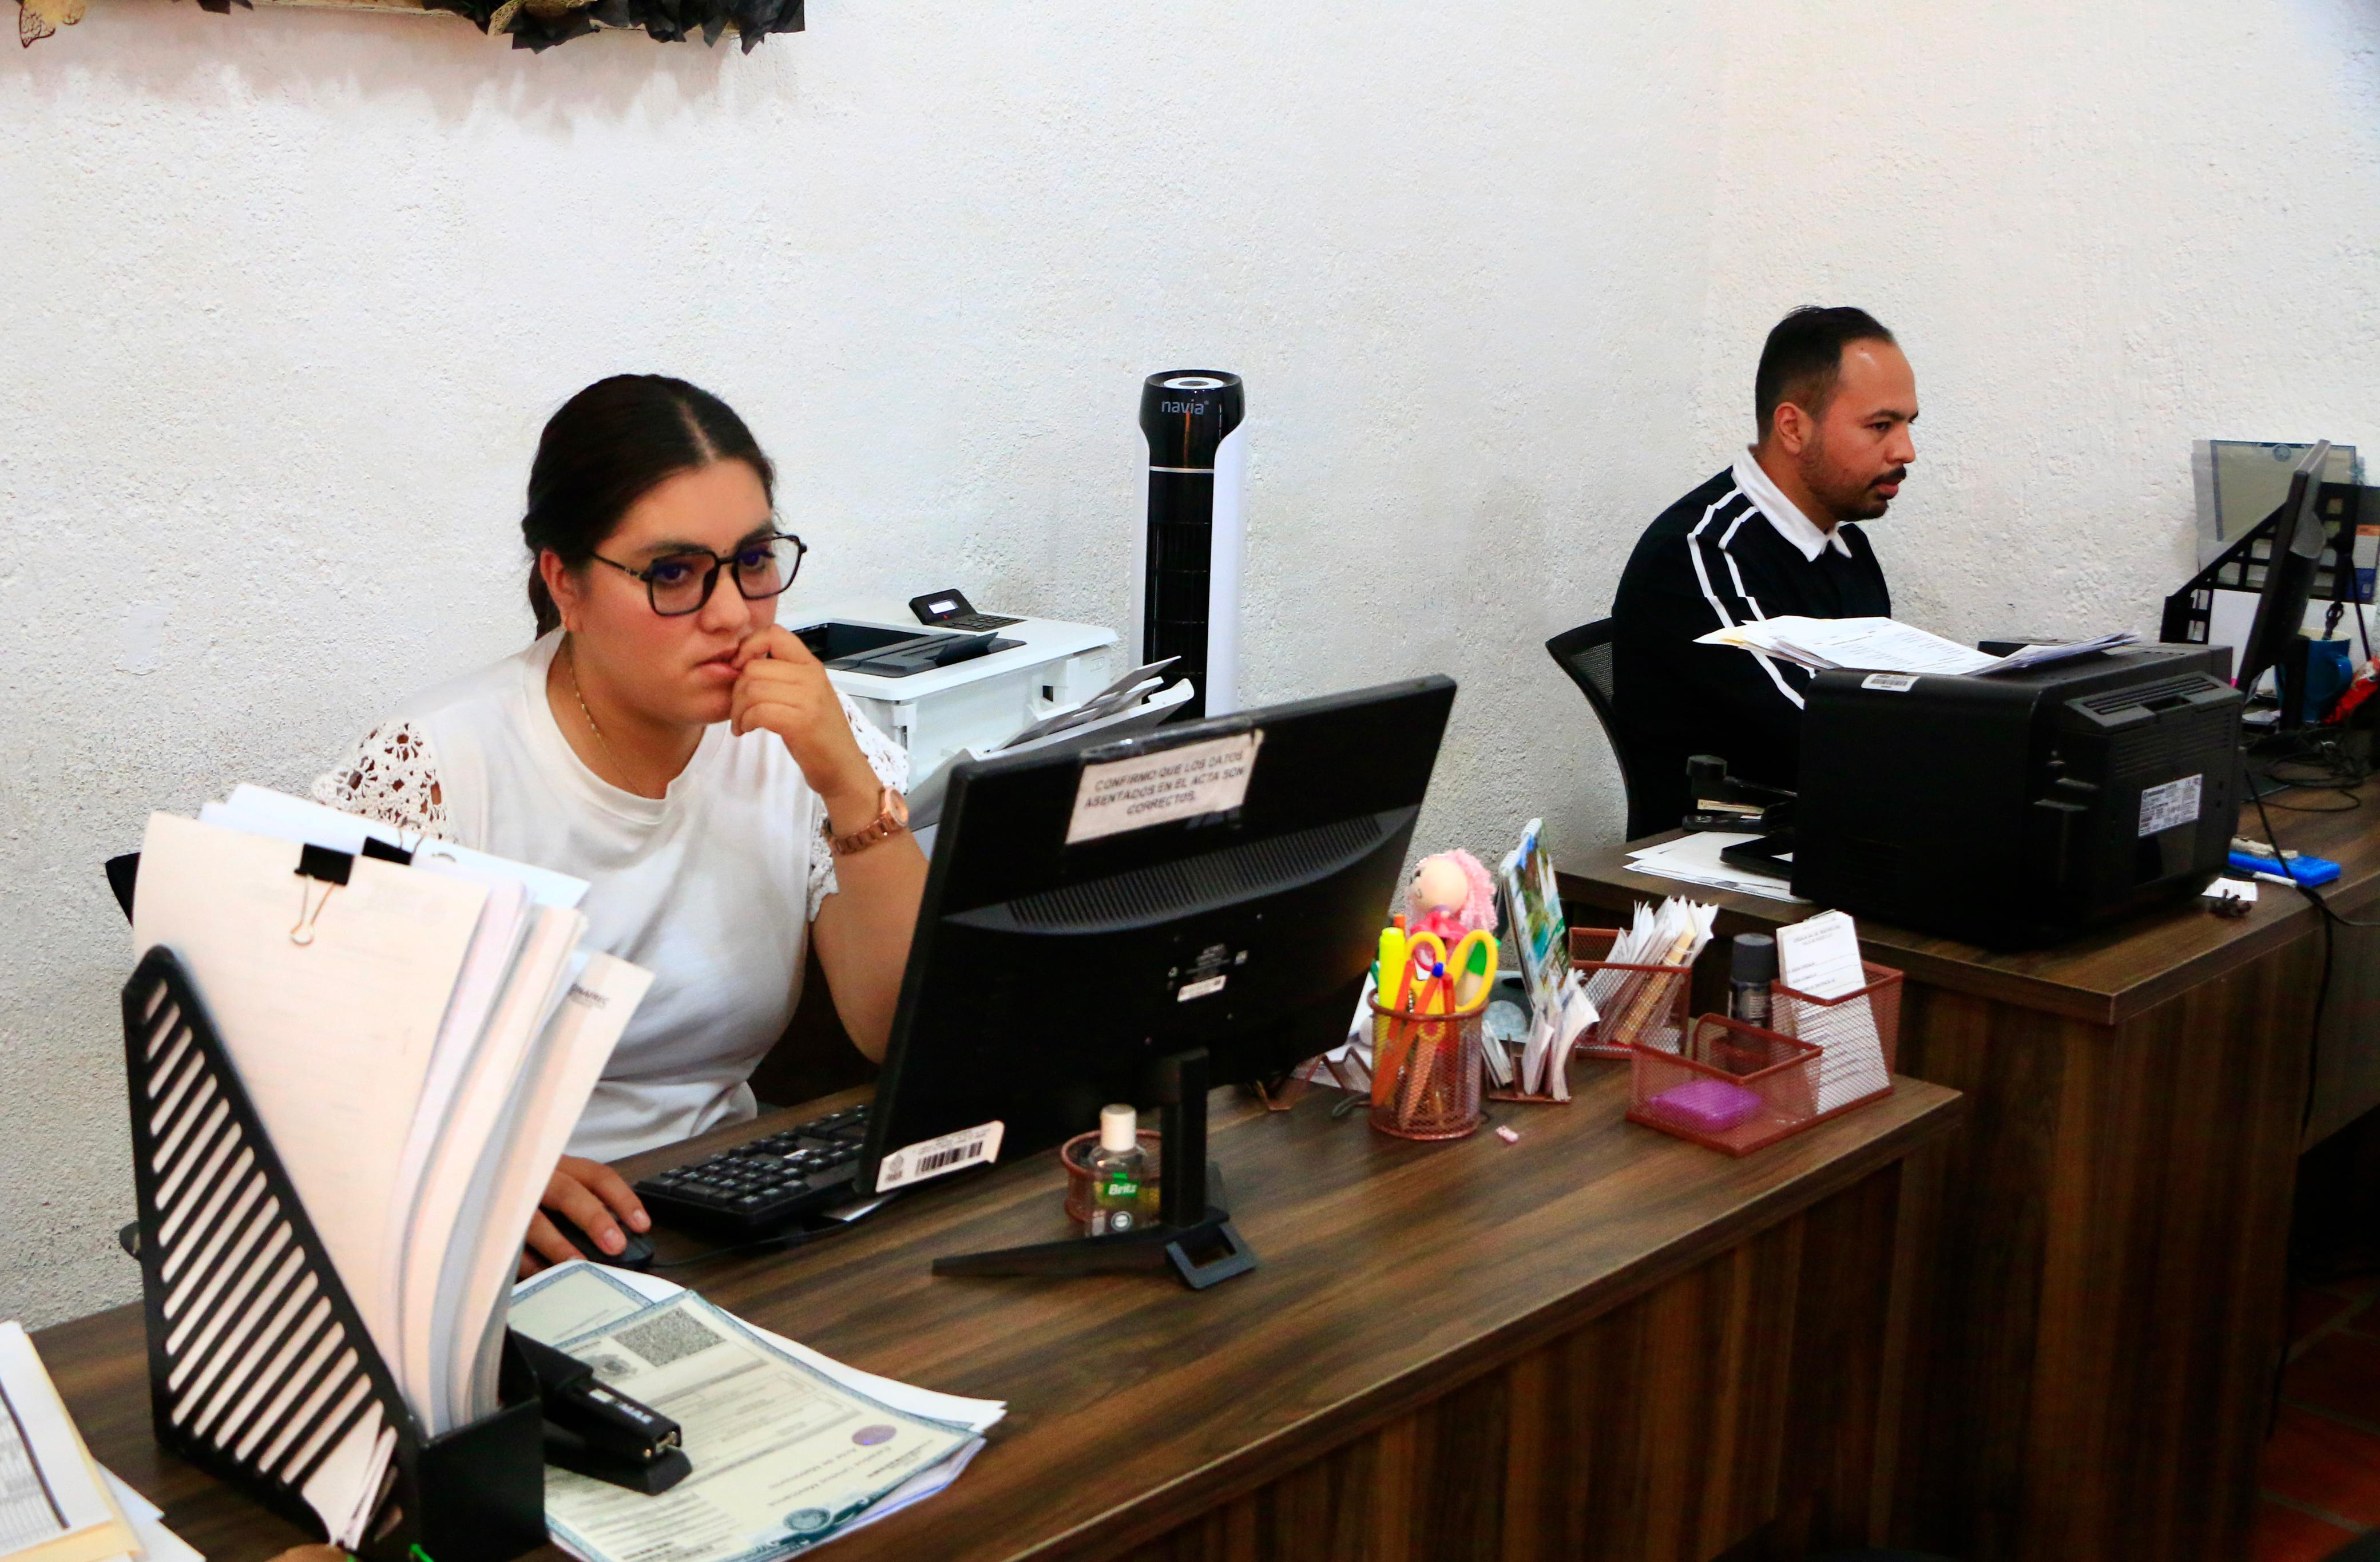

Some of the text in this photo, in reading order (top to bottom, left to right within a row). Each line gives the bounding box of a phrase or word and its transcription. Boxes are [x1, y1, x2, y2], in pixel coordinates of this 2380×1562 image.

[1161, 399, 1204, 415] navia
[1085, 766, 1245, 808] ASENTADOS EN EL ACTA SON
[1095, 750, 1243, 792] CONFIRMO QUE LOS DATOS
